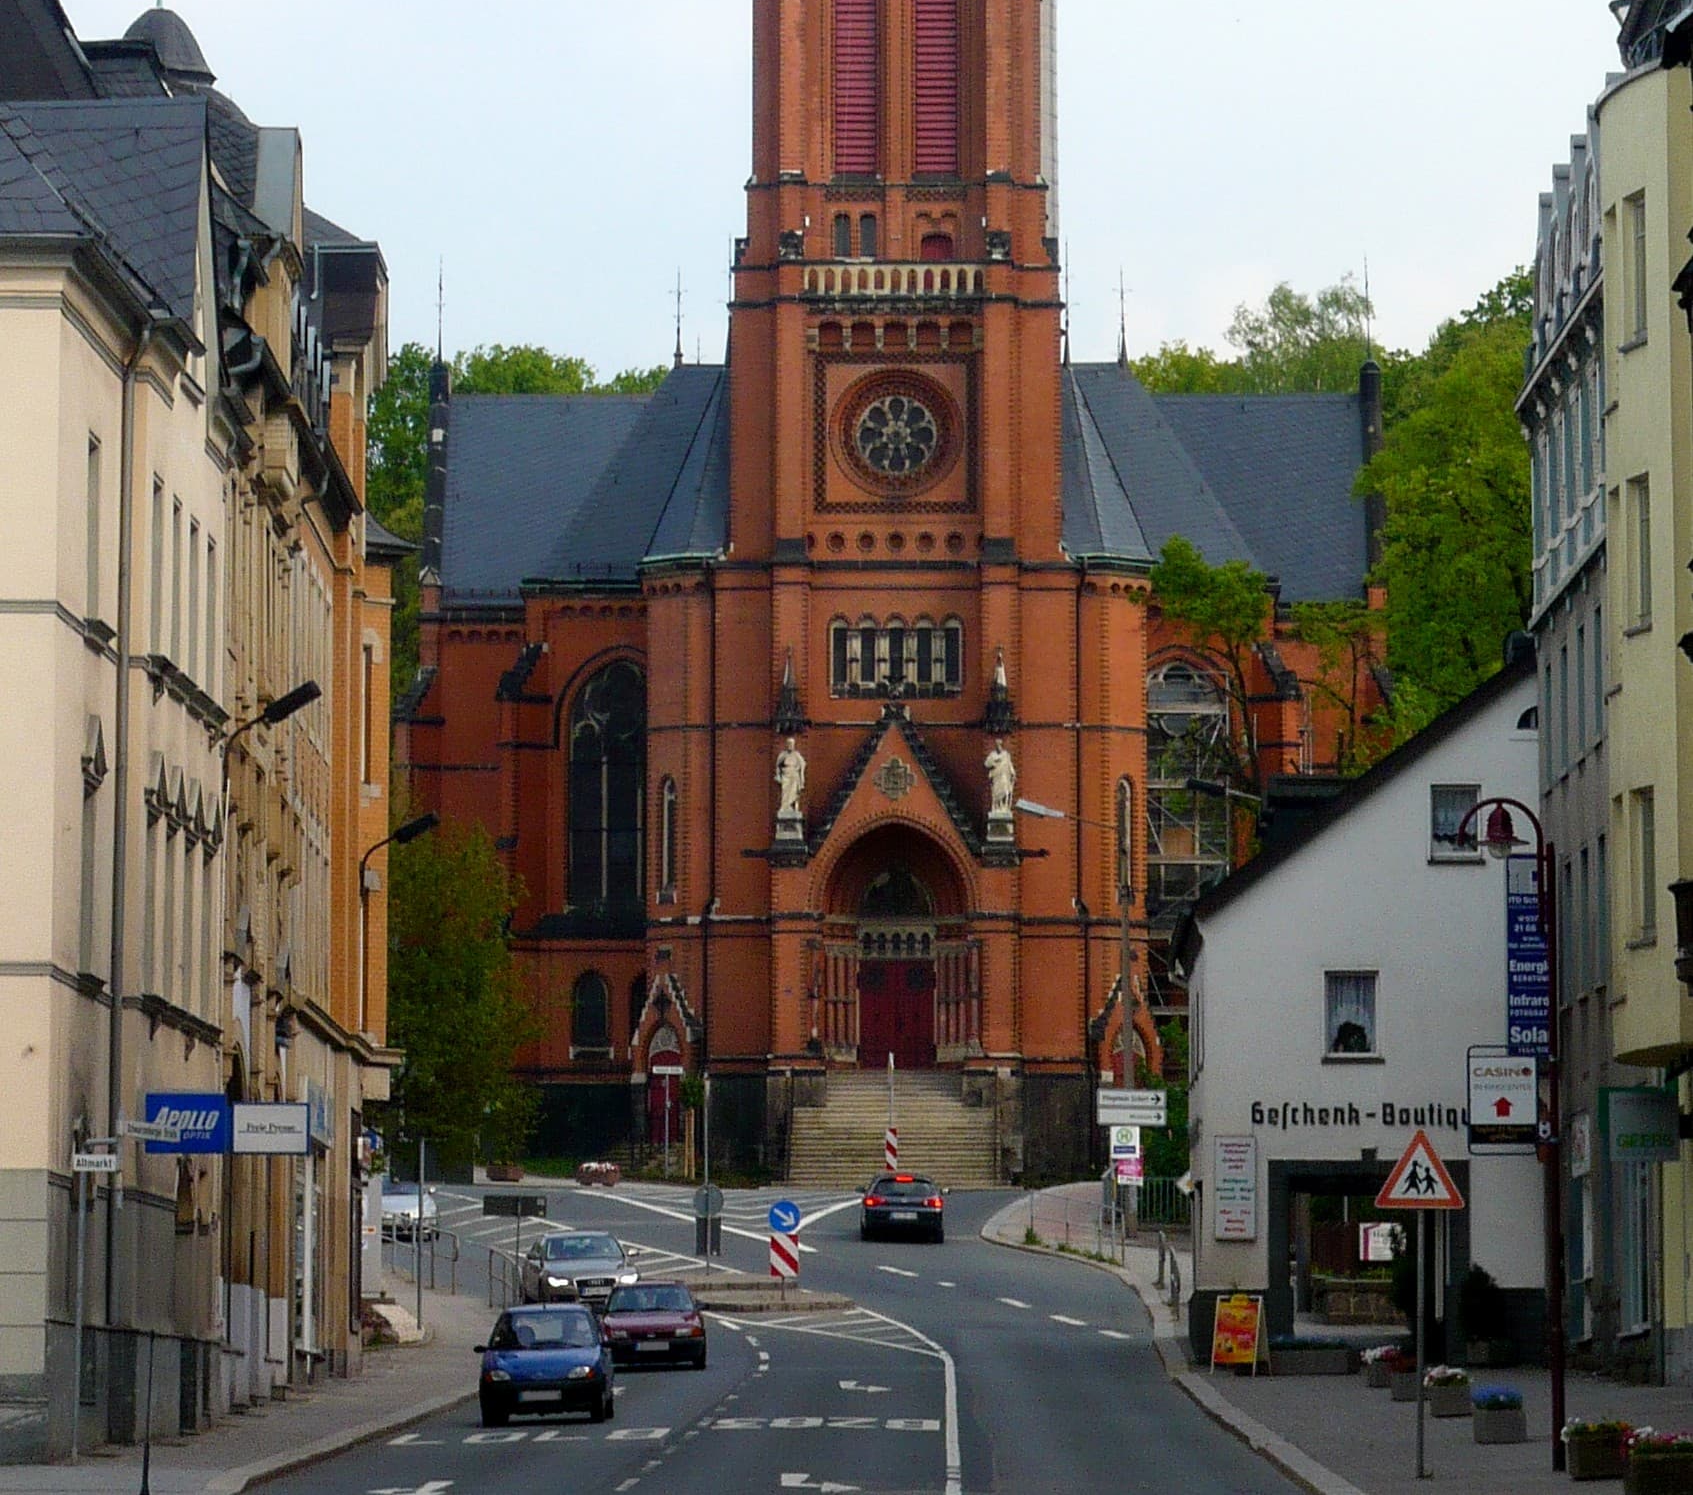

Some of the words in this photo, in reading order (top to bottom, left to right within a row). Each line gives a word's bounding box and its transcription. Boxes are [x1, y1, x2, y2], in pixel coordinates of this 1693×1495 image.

[1509, 959, 1549, 974] Energi
[1512, 974, 1549, 982] BERATUN
[1509, 994, 1550, 1007] Infraro
[1510, 1026, 1548, 1043] Sola
[1473, 1067, 1533, 1078] CASINO
[154, 1107, 220, 1130] APOLLO
[182, 1130, 211, 1140] OPTIK
[76, 1158, 112, 1169] Altmarkt
